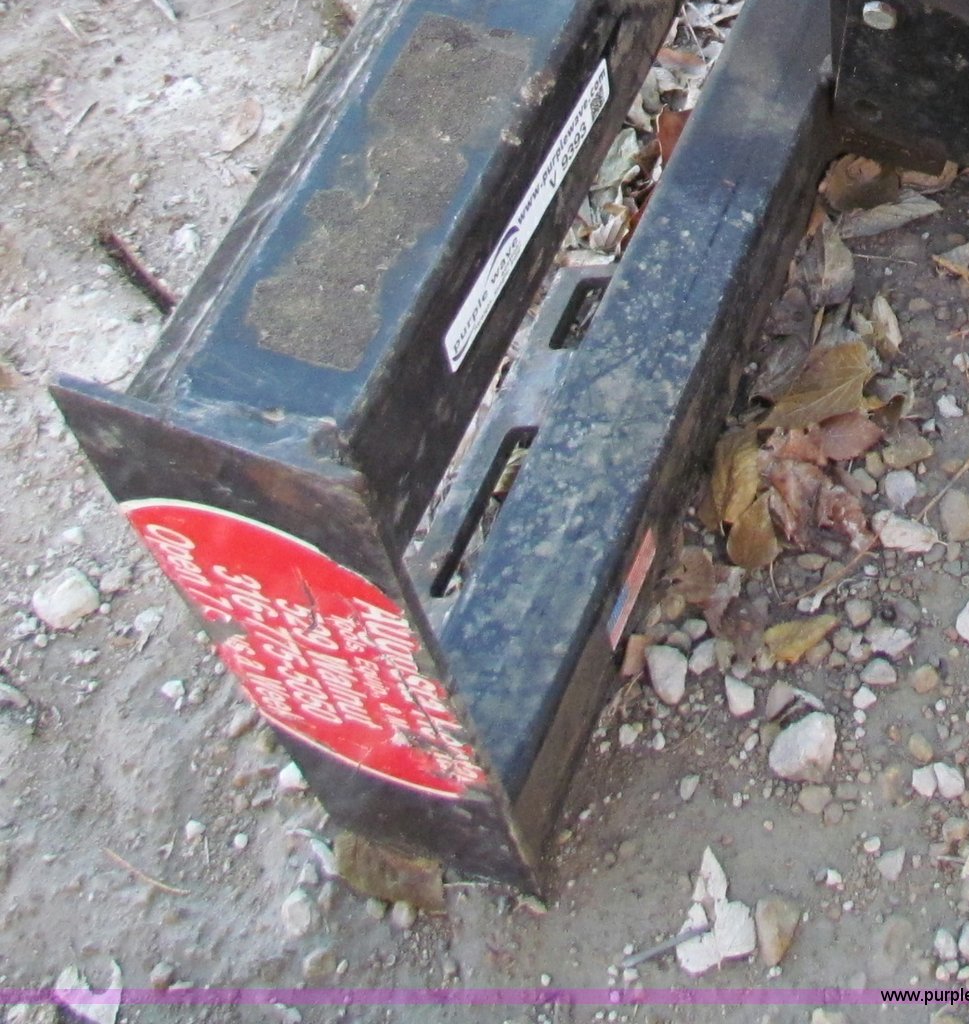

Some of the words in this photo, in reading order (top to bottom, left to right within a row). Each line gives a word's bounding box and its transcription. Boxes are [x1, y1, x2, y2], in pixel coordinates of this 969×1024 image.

[517, 69, 605, 224] www.purplewave.com
[559, 121, 588, 170] 9393
[453, 289, 488, 354] purple
[489, 237, 517, 282] wave
[146, 524, 211, 587] Open
[209, 562, 343, 724] 316-775-5050
[270, 595, 339, 651] 529
[302, 647, 383, 731] Walnut
